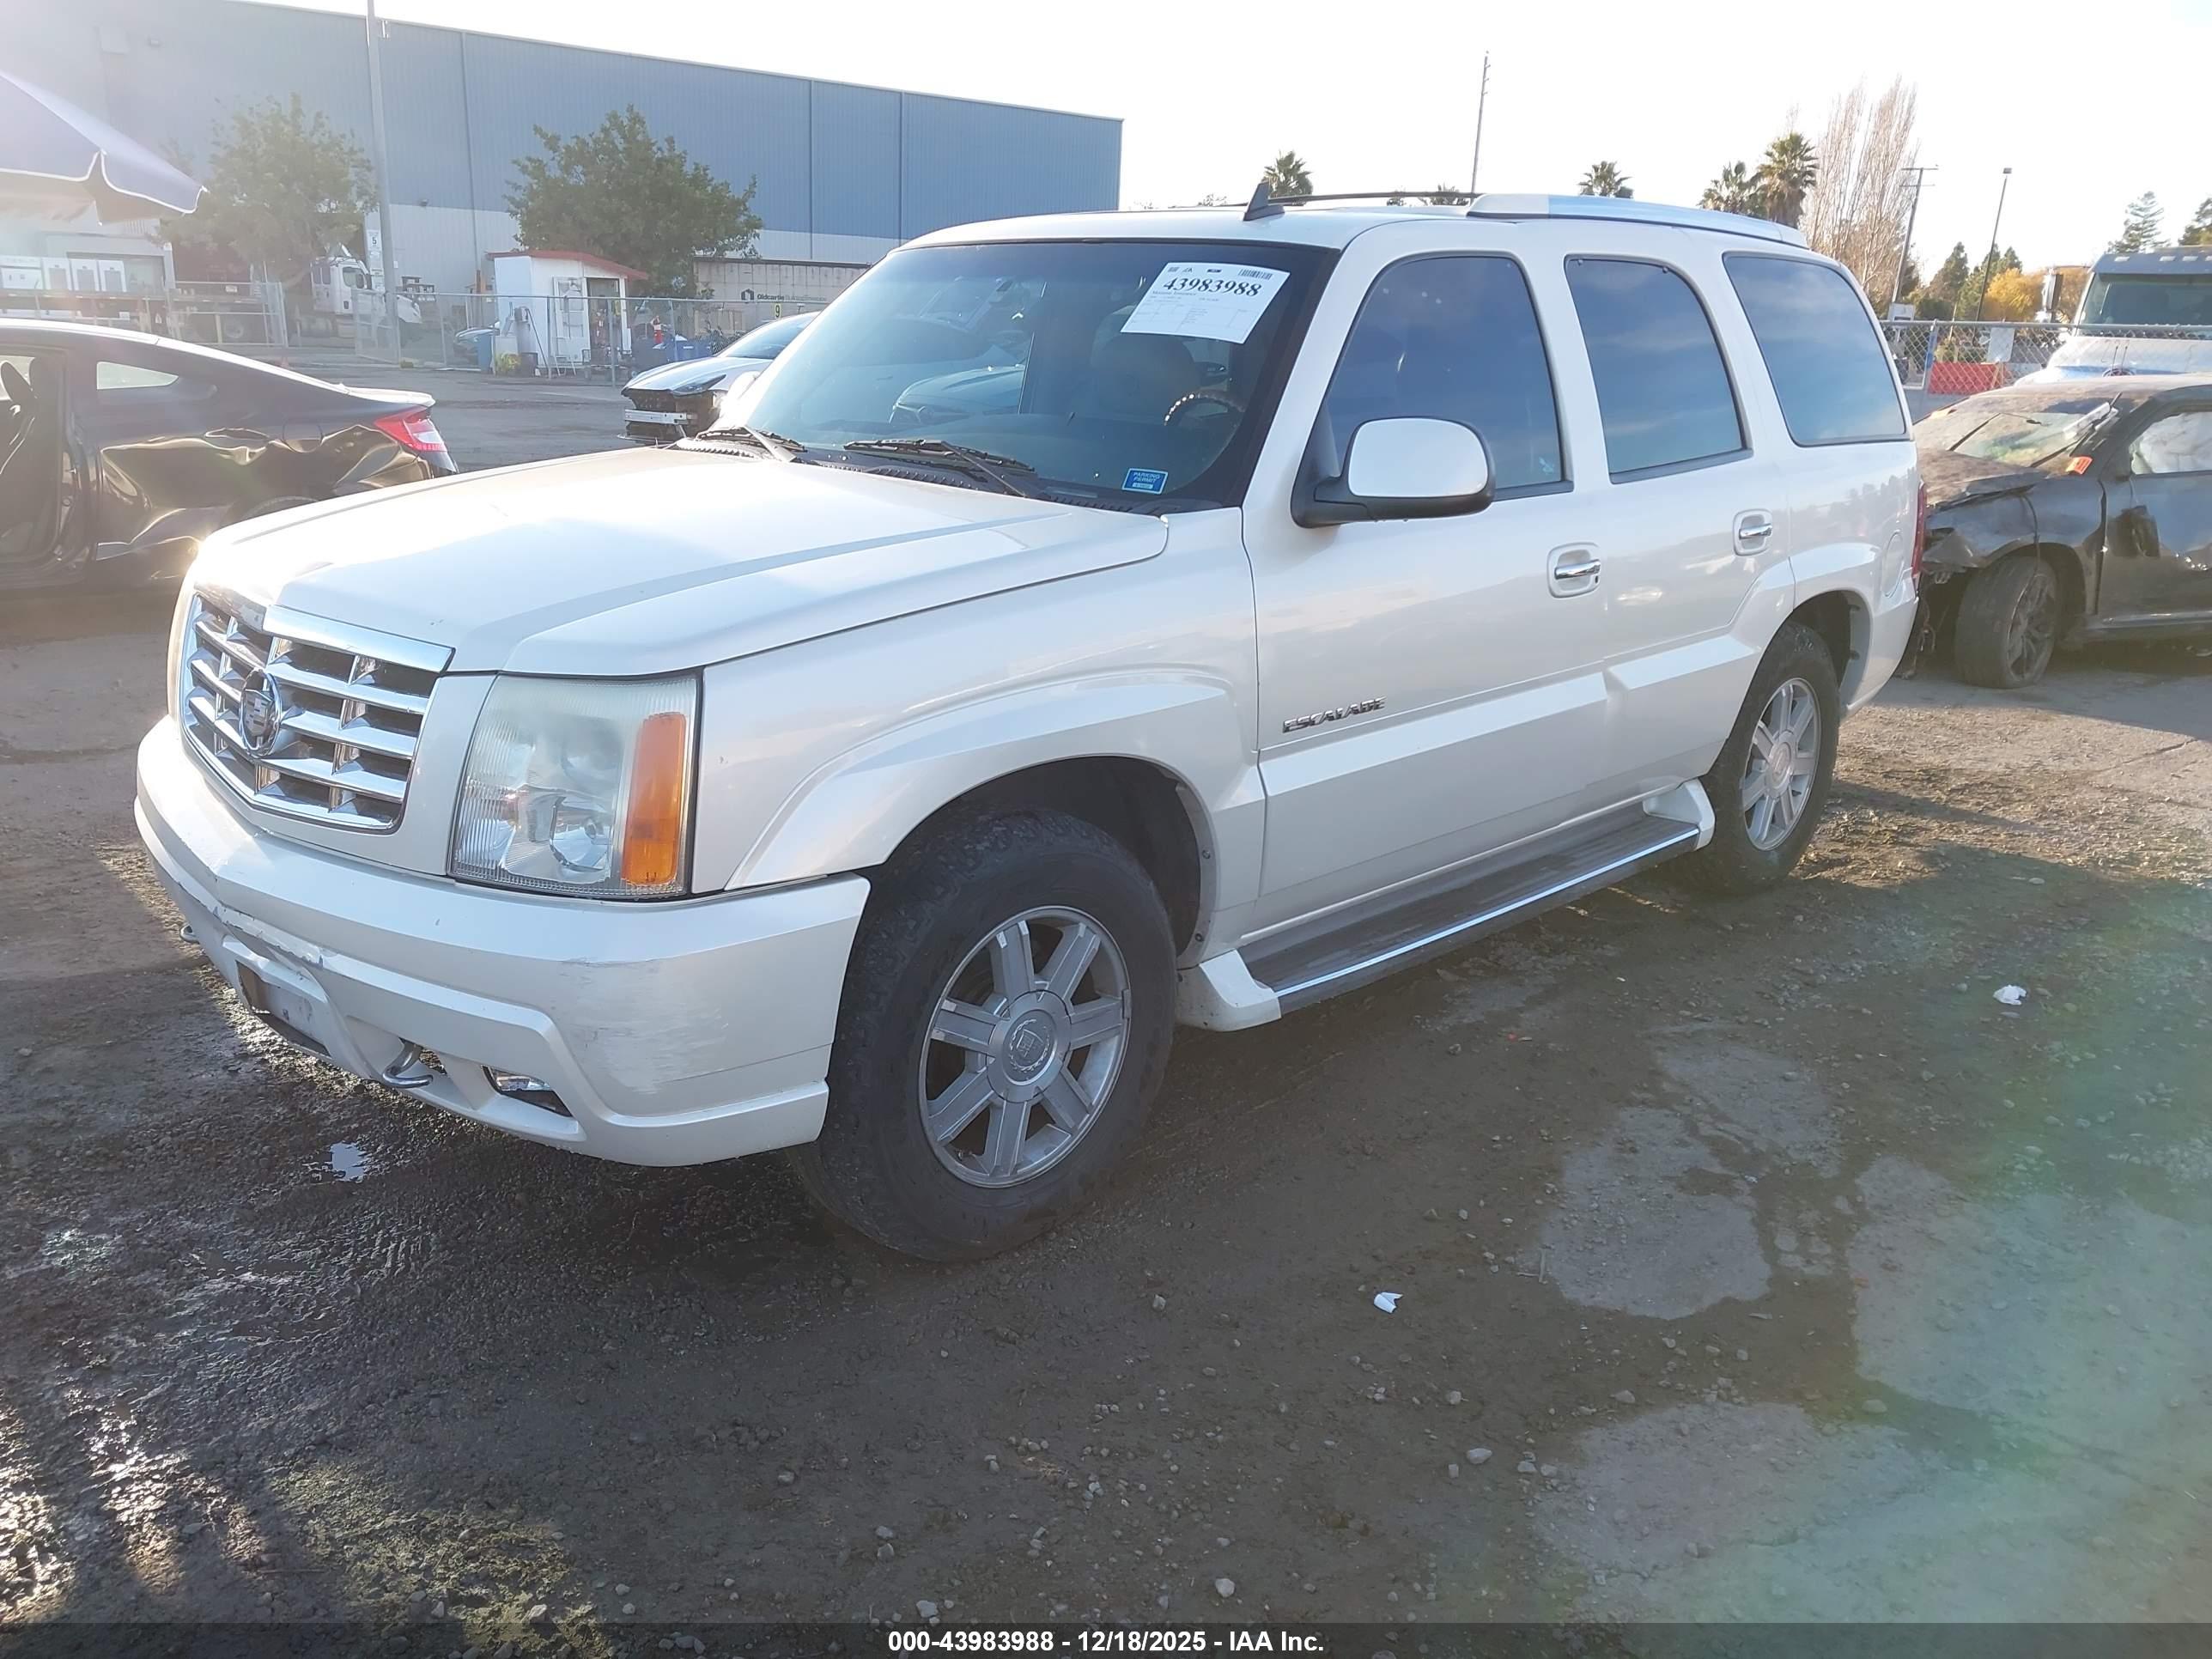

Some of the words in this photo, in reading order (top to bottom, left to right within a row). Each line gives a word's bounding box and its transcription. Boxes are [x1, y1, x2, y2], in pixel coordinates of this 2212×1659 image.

[1164, 276, 1262, 297] 43983988
[775, 305, 781, 318] 9
[1282, 696, 1387, 733] ESCALADE
